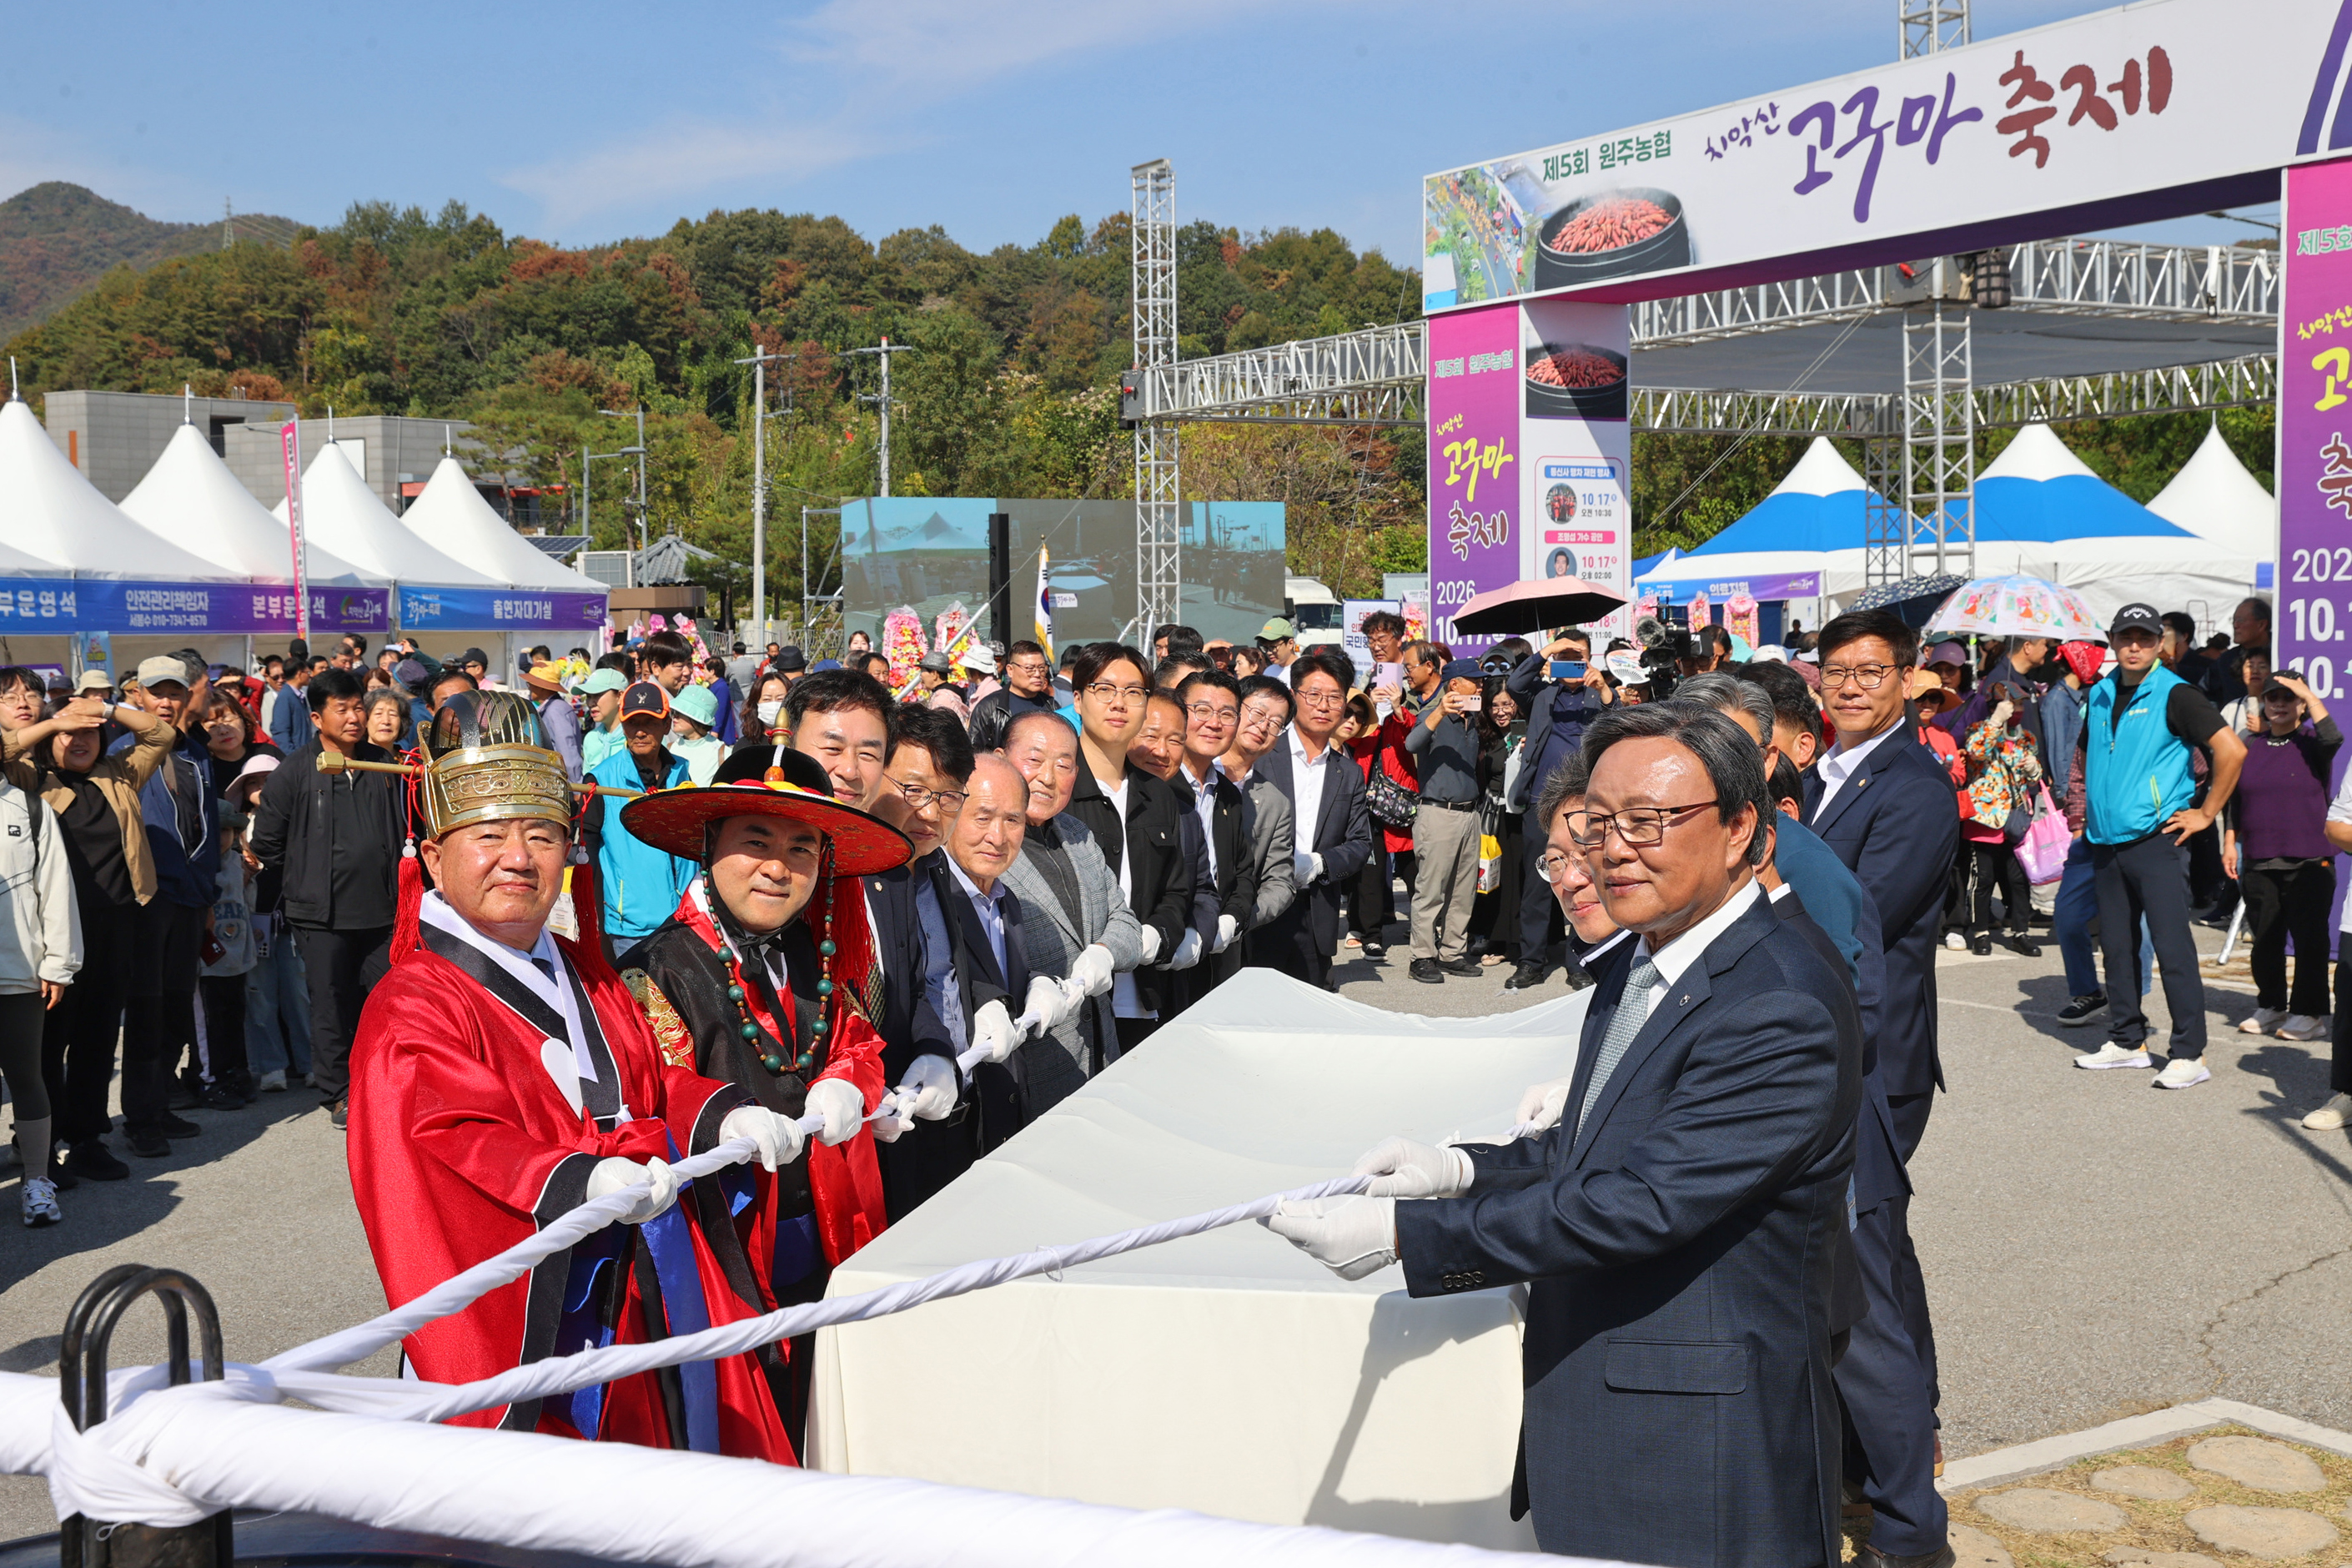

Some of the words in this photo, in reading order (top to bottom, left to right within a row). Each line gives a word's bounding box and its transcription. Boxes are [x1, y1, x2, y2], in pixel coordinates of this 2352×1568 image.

[1705, 102, 1781, 161] 치악산
[1787, 72, 1984, 223] 고구마
[1996, 45, 2174, 168] 축제
[1543, 148, 1589, 182] 제5회
[1599, 129, 1671, 170] 원주농협
[1435, 357, 1464, 378] 제5회
[1469, 349, 1514, 374] 원주농협
[1435, 413, 1464, 436] 치악산
[1443, 436, 1514, 502] 고구마
[1595, 509, 1611, 517] 10:30
[1448, 500, 1509, 561] 축제
[1594, 571, 1611, 580] 02:00
[126, 590, 209, 611] 안전관리책임자
[1436, 580, 1476, 605] 2026
[1709, 581, 1750, 596] 의료지원
[494, 599, 552, 620] 출연자대기실
[2289, 598, 2352, 641] 10.
